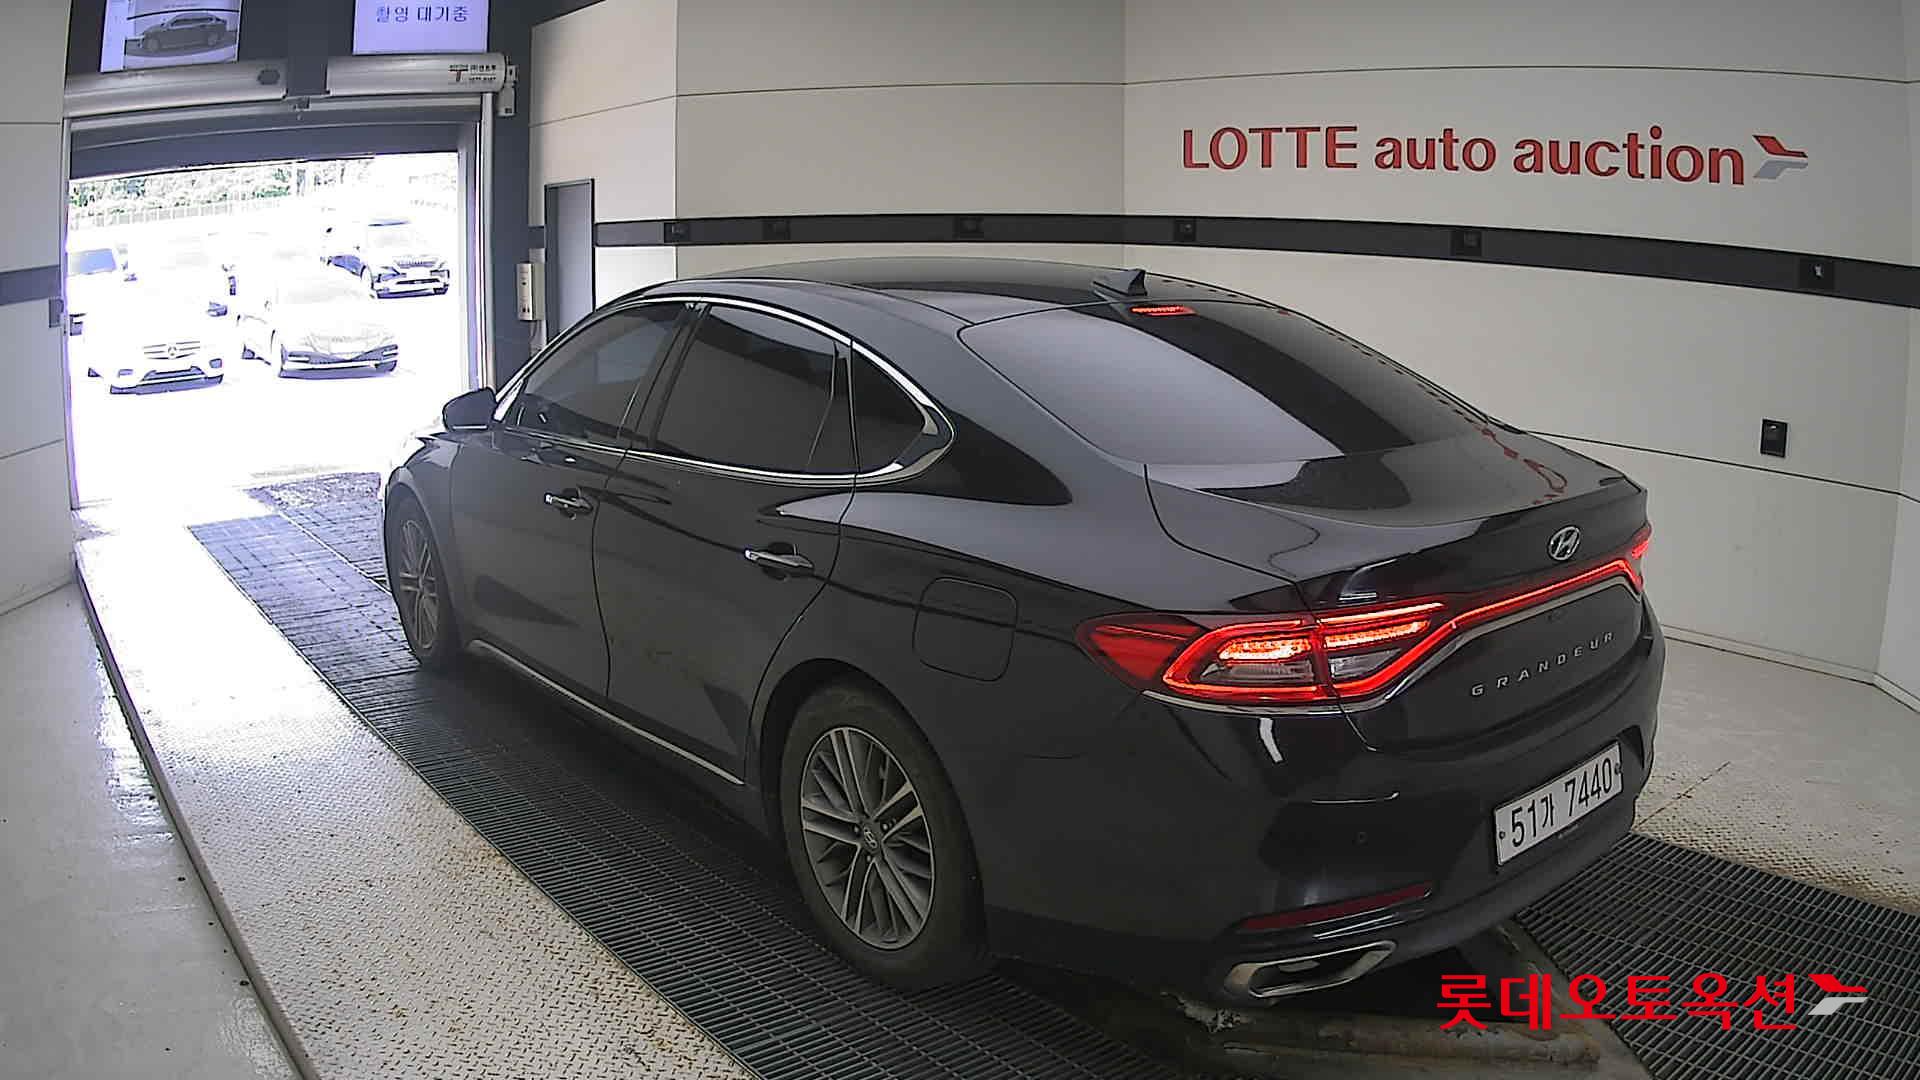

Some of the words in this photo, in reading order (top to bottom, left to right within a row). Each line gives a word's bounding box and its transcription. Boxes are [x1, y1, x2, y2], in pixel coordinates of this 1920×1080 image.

[416, 5, 468, 23] 대기중
[1183, 126, 1358, 169] LOTTE
[1374, 128, 1497, 171] auto
[1513, 125, 1745, 185] auction
[1471, 631, 1614, 697] GRANDEUR
[1511, 793, 1554, 848] 51가
[1564, 758, 1613, 817] 7440
